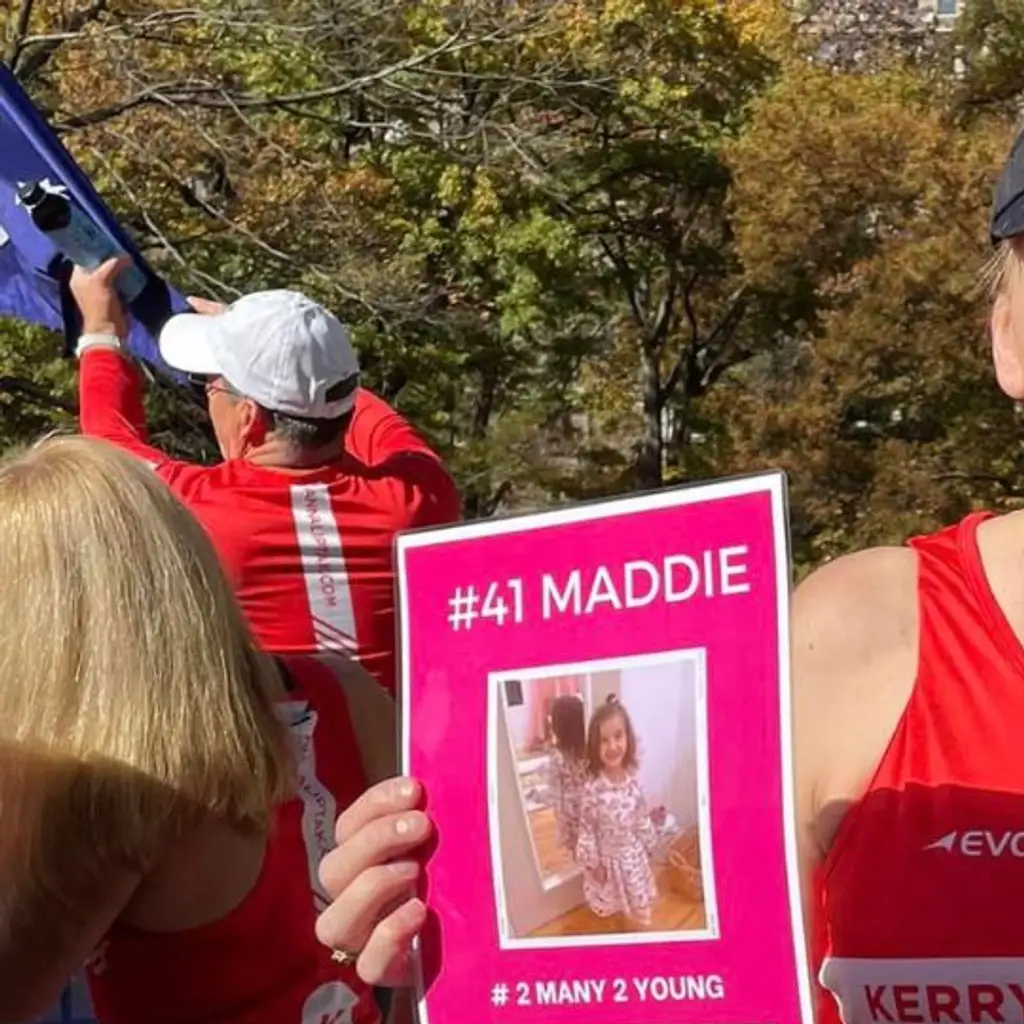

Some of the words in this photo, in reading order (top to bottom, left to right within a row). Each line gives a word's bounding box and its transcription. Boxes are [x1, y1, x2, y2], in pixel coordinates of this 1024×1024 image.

[447, 577, 523, 631] #41
[542, 545, 750, 620] MADDIE
[516, 982, 531, 1006] 2
[536, 979, 607, 1005] MANY
[613, 978, 629, 1002] 2
[634, 975, 725, 1001] YOUNG
